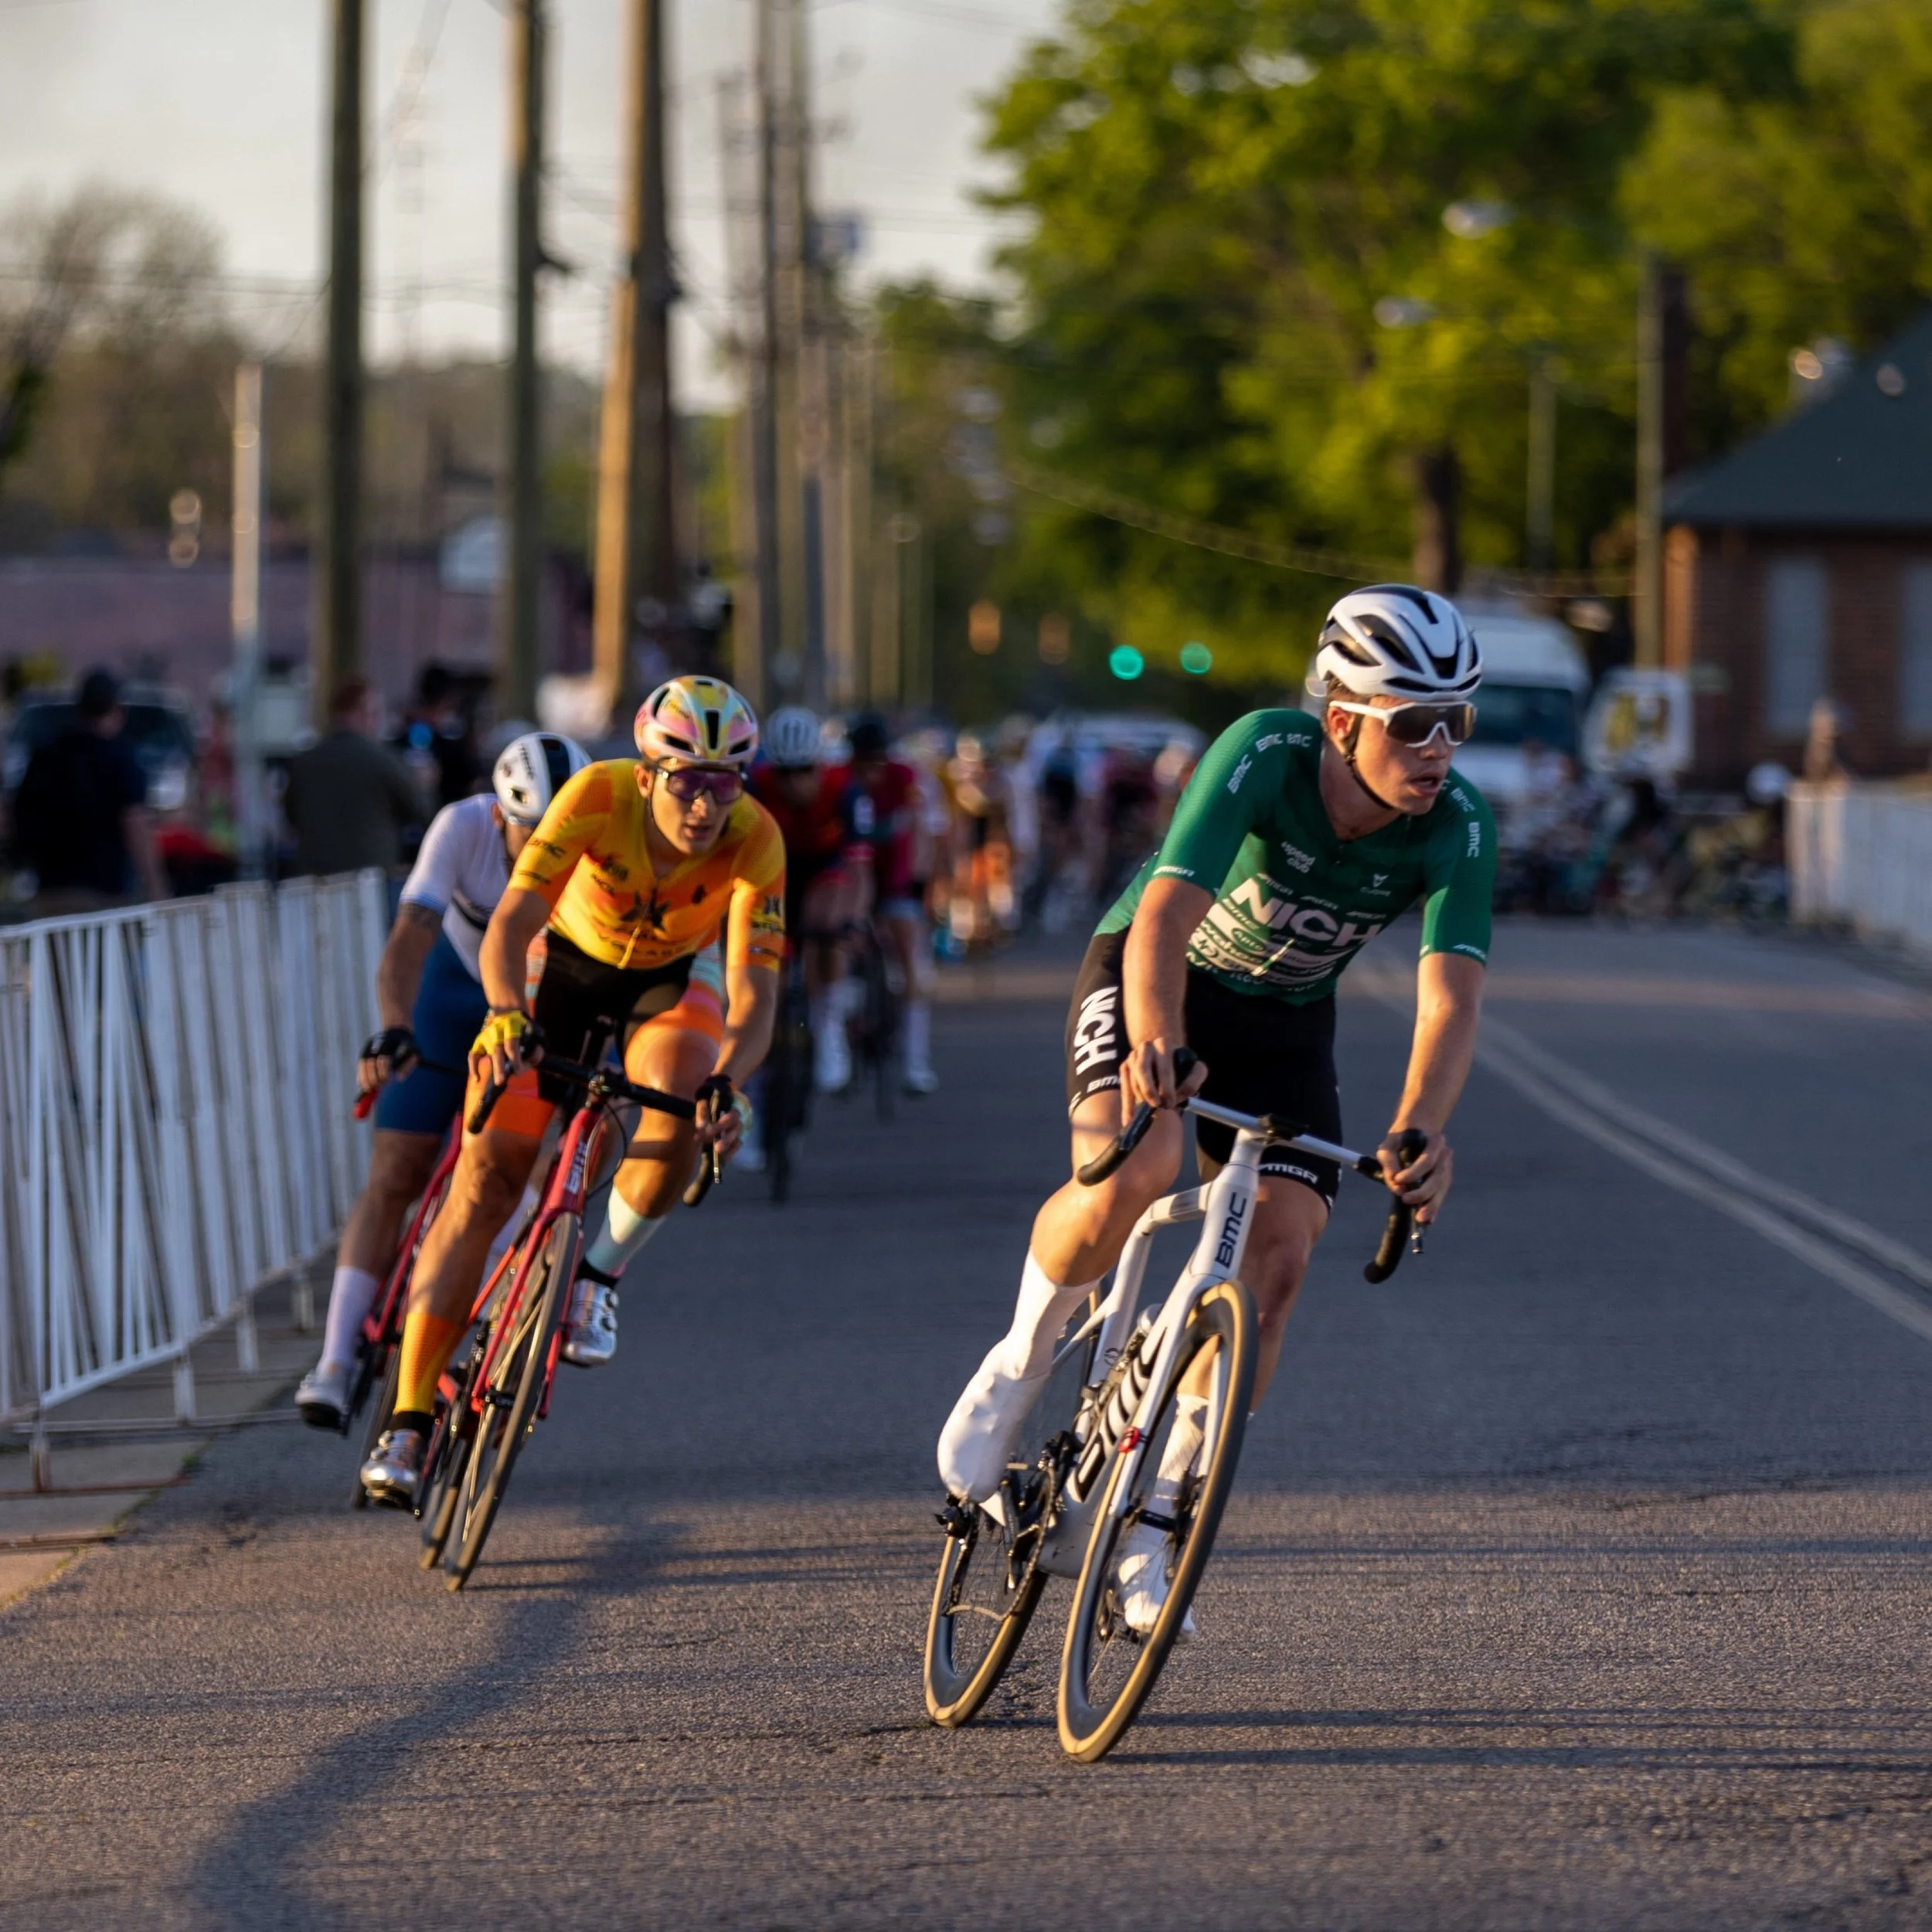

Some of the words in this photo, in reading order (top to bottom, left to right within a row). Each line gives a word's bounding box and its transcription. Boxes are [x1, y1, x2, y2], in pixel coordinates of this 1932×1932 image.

[1227, 754, 1252, 794] BMC
[1467, 821, 1481, 858] BMC
[1230, 877, 1383, 947] NICH
[1073, 986, 1119, 1076] NICH
[1087, 1075, 1121, 1094] BM
[1215, 1192, 1247, 1269] BMC
